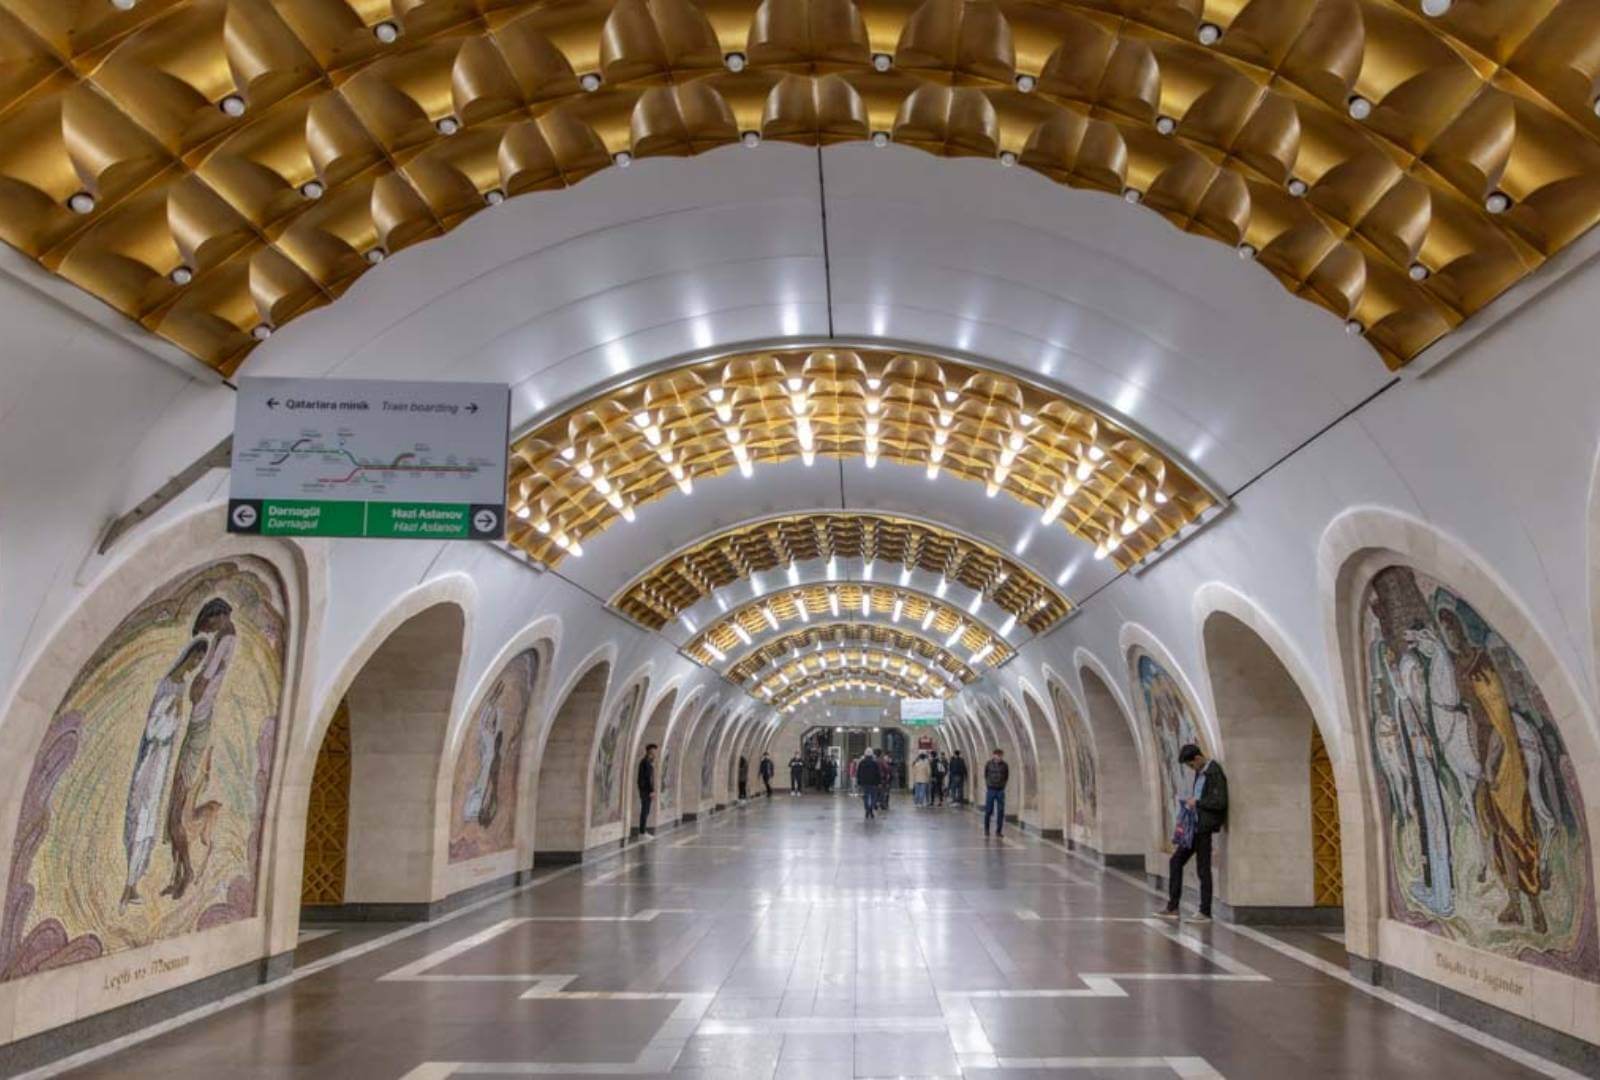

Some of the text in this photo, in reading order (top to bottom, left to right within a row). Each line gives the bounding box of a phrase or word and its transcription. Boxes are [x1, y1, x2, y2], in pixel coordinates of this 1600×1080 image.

[382, 401, 459, 415] Train boarding
[418, 509, 463, 520] Aslanov
